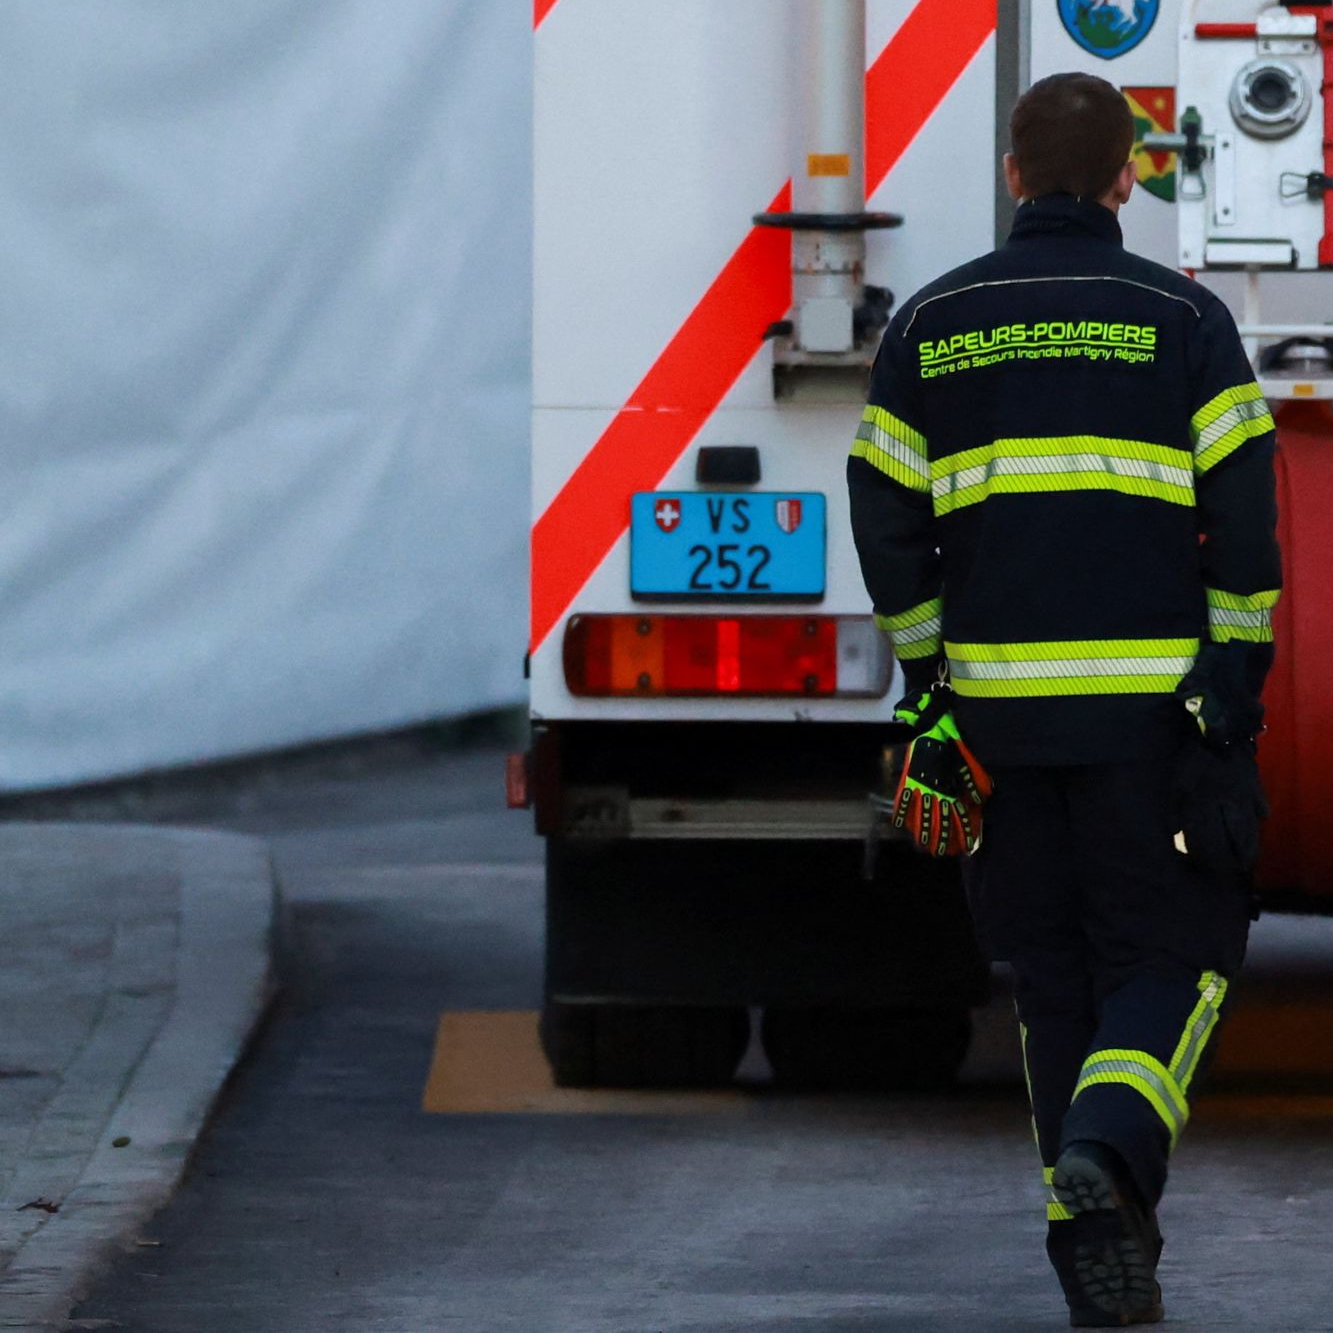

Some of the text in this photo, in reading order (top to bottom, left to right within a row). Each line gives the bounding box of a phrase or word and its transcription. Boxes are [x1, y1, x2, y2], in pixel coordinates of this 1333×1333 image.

[918, 321, 1157, 361] SAPEURS-POMPIERS
[920, 345, 1154, 378] Centre de Secours Incendie Martigny Région
[706, 498, 751, 534] VS
[688, 544, 772, 591] 252
